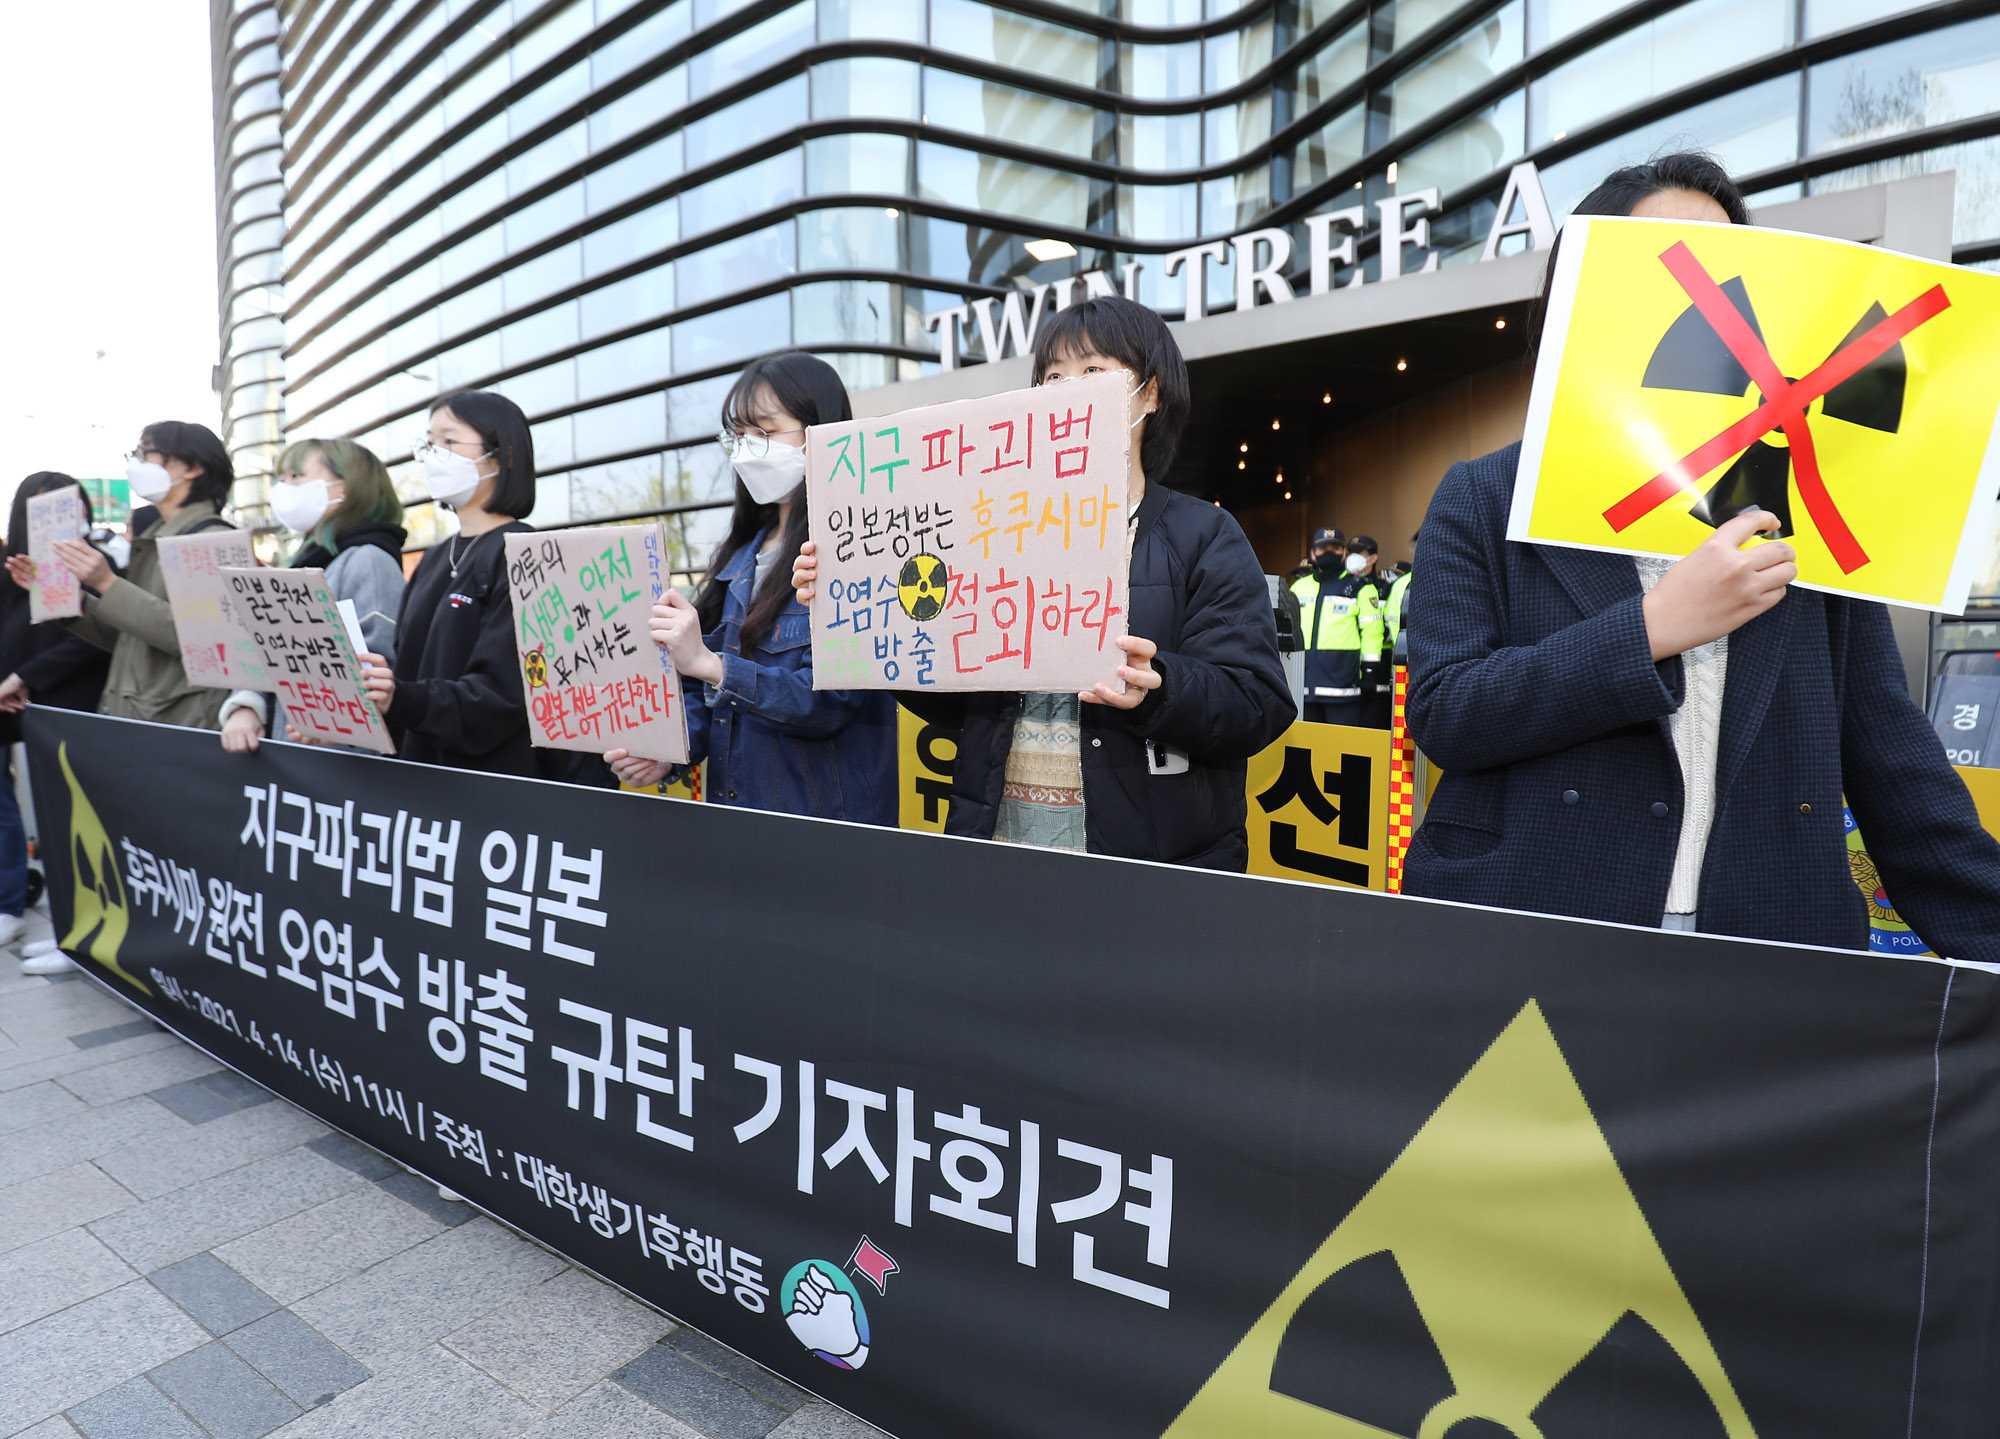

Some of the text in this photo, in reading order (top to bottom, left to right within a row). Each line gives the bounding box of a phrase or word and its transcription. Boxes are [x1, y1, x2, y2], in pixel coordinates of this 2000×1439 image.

[1165, 186, 1442, 322] TREE
[1479, 160, 1557, 263] A
[827, 403, 1093, 494] 지구 파괴범
[967, 484, 1120, 560] 후쿠시마
[511, 538, 566, 601] 인류의
[579, 536, 641, 620] 안전
[826, 564, 1122, 674] 오염수 철회하라
[874, 626, 936, 685] 방출
[278, 679, 372, 735] 규탄한다
[240, 783, 608, 967] 지구파괴범 일본
[121, 835, 1174, 1309] 후쿠시마 원전 오염수 방출 규탄 기자회견
[352, 1074, 413, 1136] 11시
[433, 1110, 492, 1177] 주최
[514, 1151, 771, 1314] 대학생기후행동
